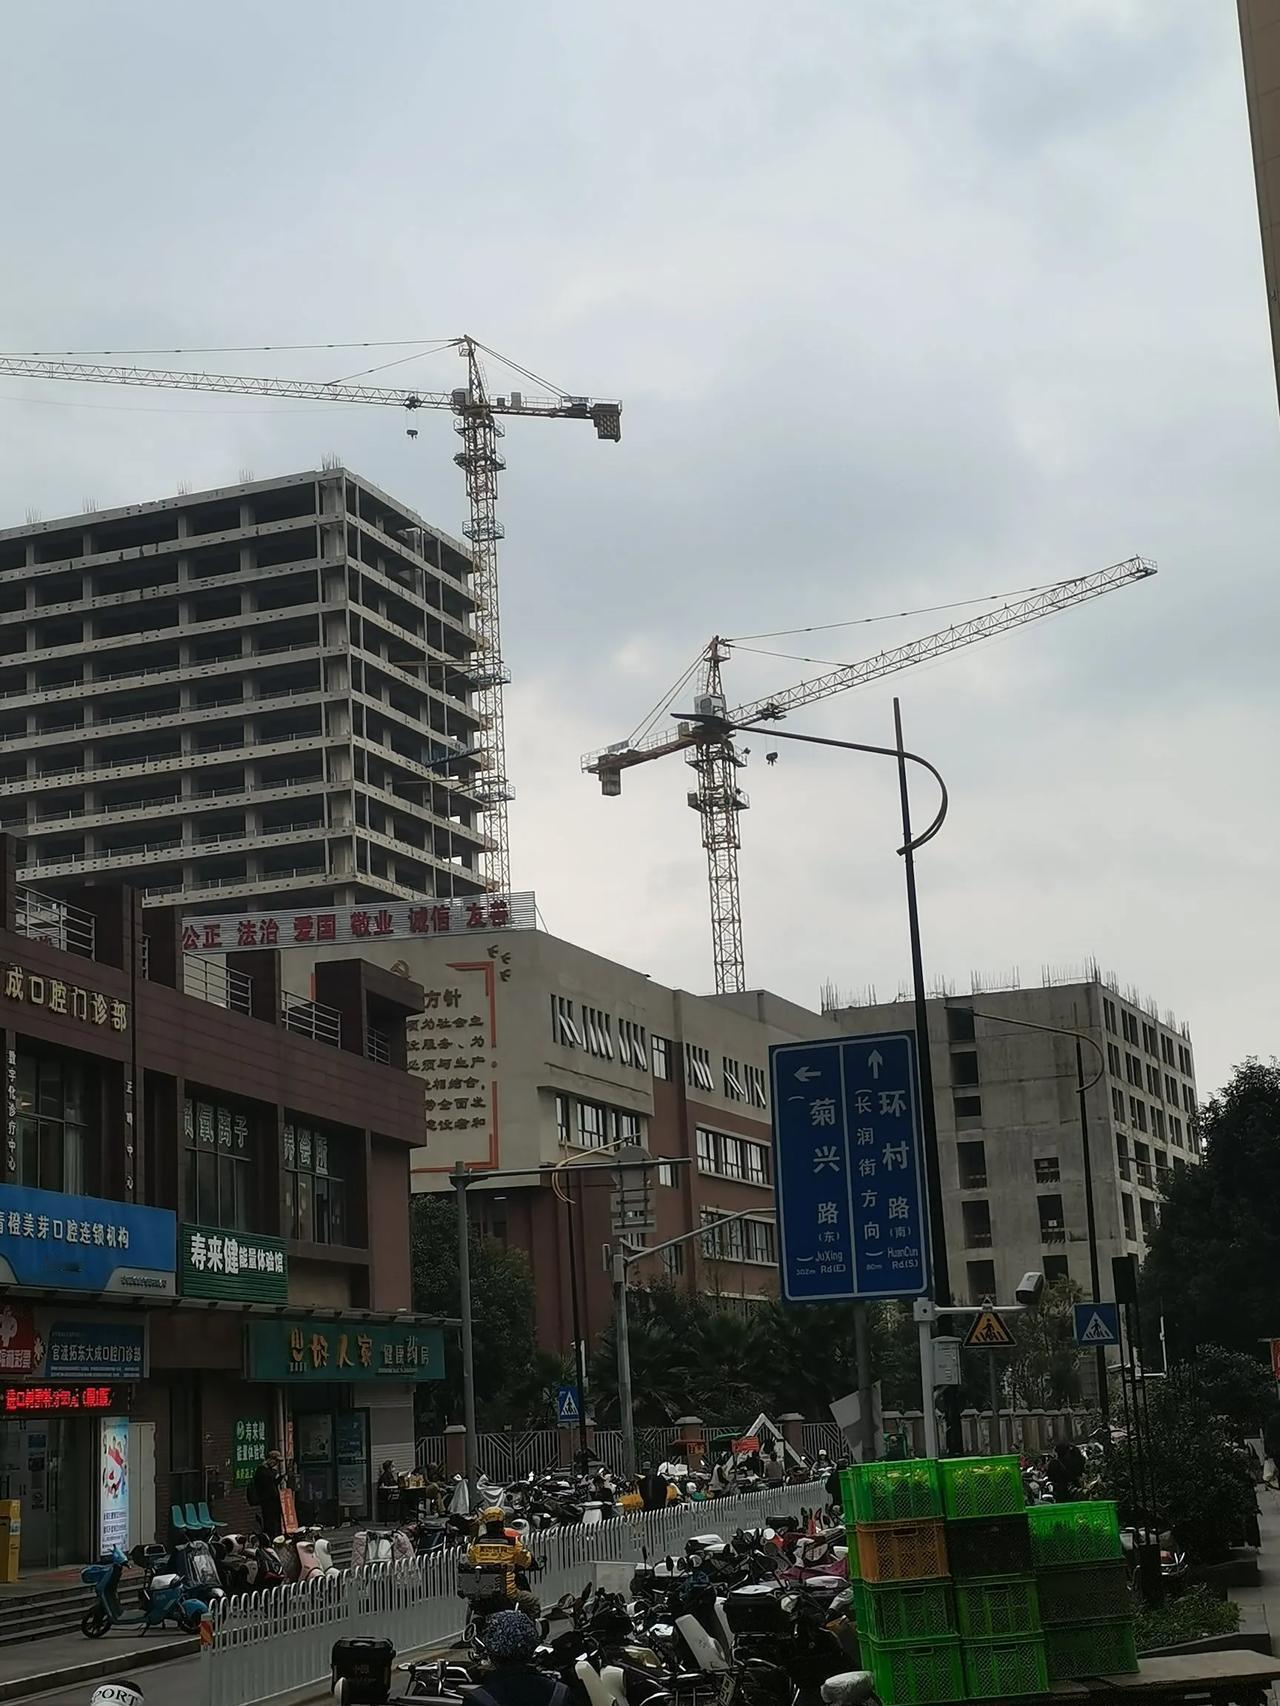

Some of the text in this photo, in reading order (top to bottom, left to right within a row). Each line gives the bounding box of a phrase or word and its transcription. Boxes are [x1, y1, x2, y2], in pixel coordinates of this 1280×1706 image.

[182, 900, 508, 949] 公正 法治 爱国 敬业 诚信 友善
[5, 962, 128, 1033] 成口腔门诊部
[424, 988, 462, 1008] 方针
[190, 1232, 284, 1274] 寿来健能量体验馆
